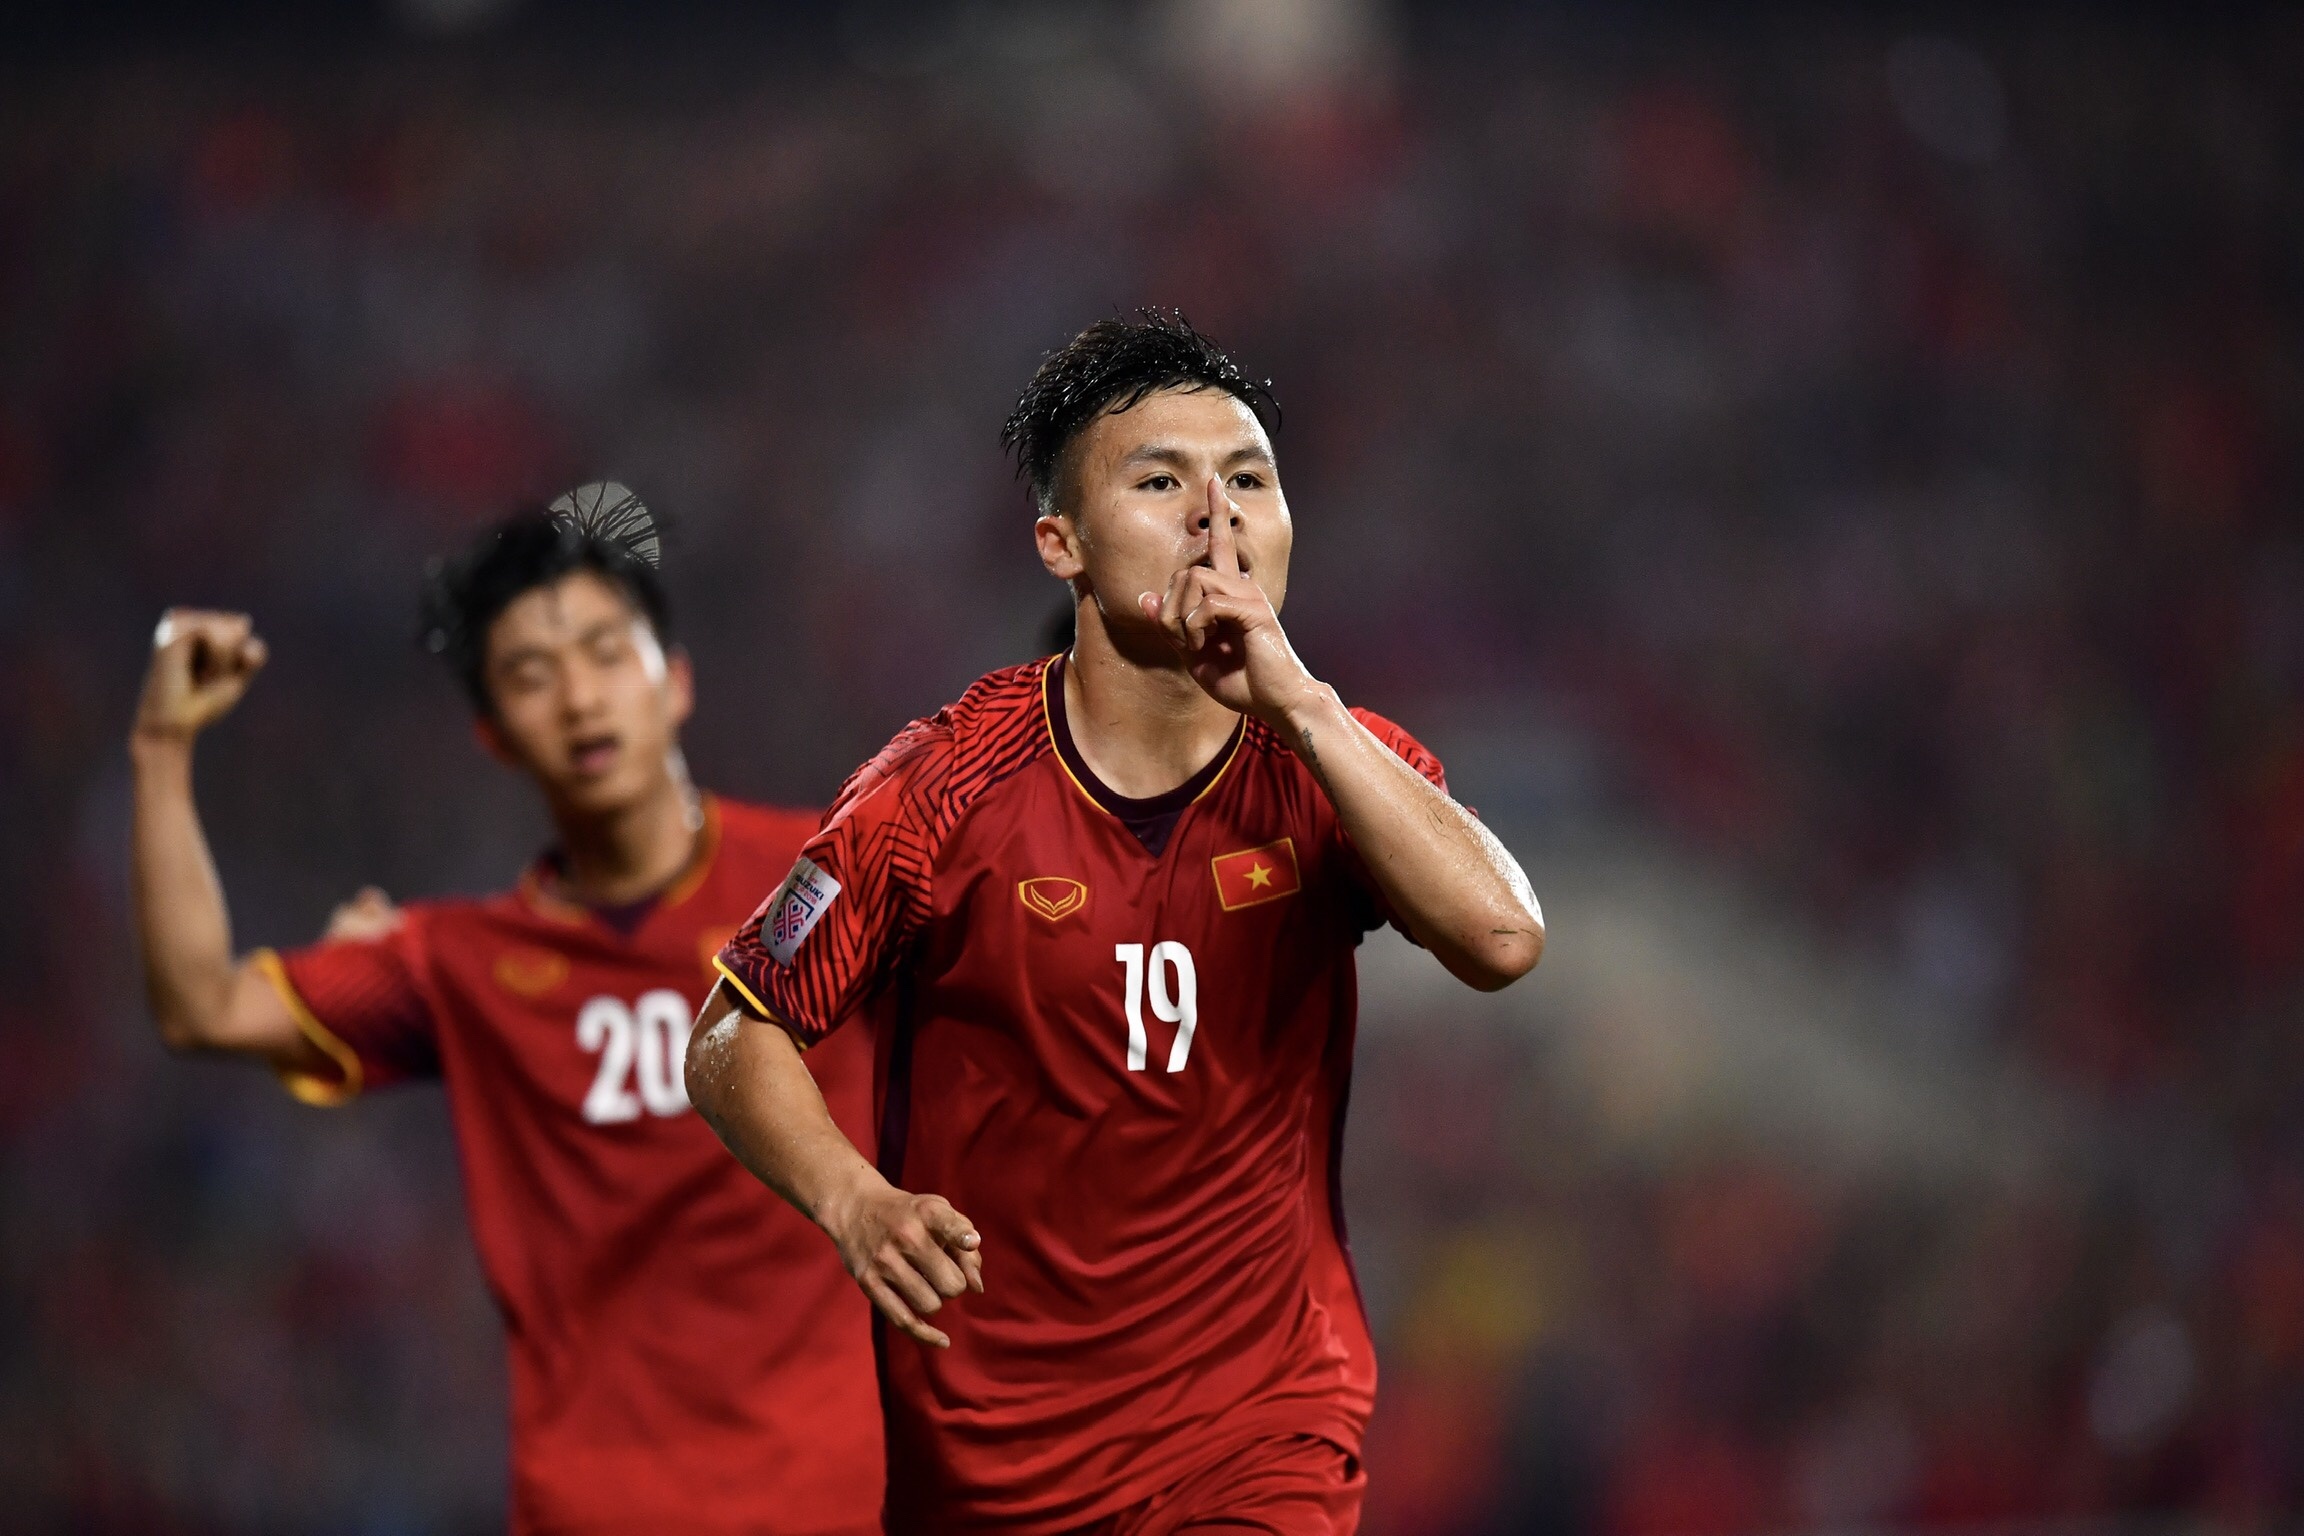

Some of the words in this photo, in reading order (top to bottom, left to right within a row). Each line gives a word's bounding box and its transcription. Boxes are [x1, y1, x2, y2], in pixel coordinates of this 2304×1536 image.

[796, 874, 825, 901] SUZUKI
[576, 989, 691, 1124] 20
[1115, 940, 1198, 1073] 19
